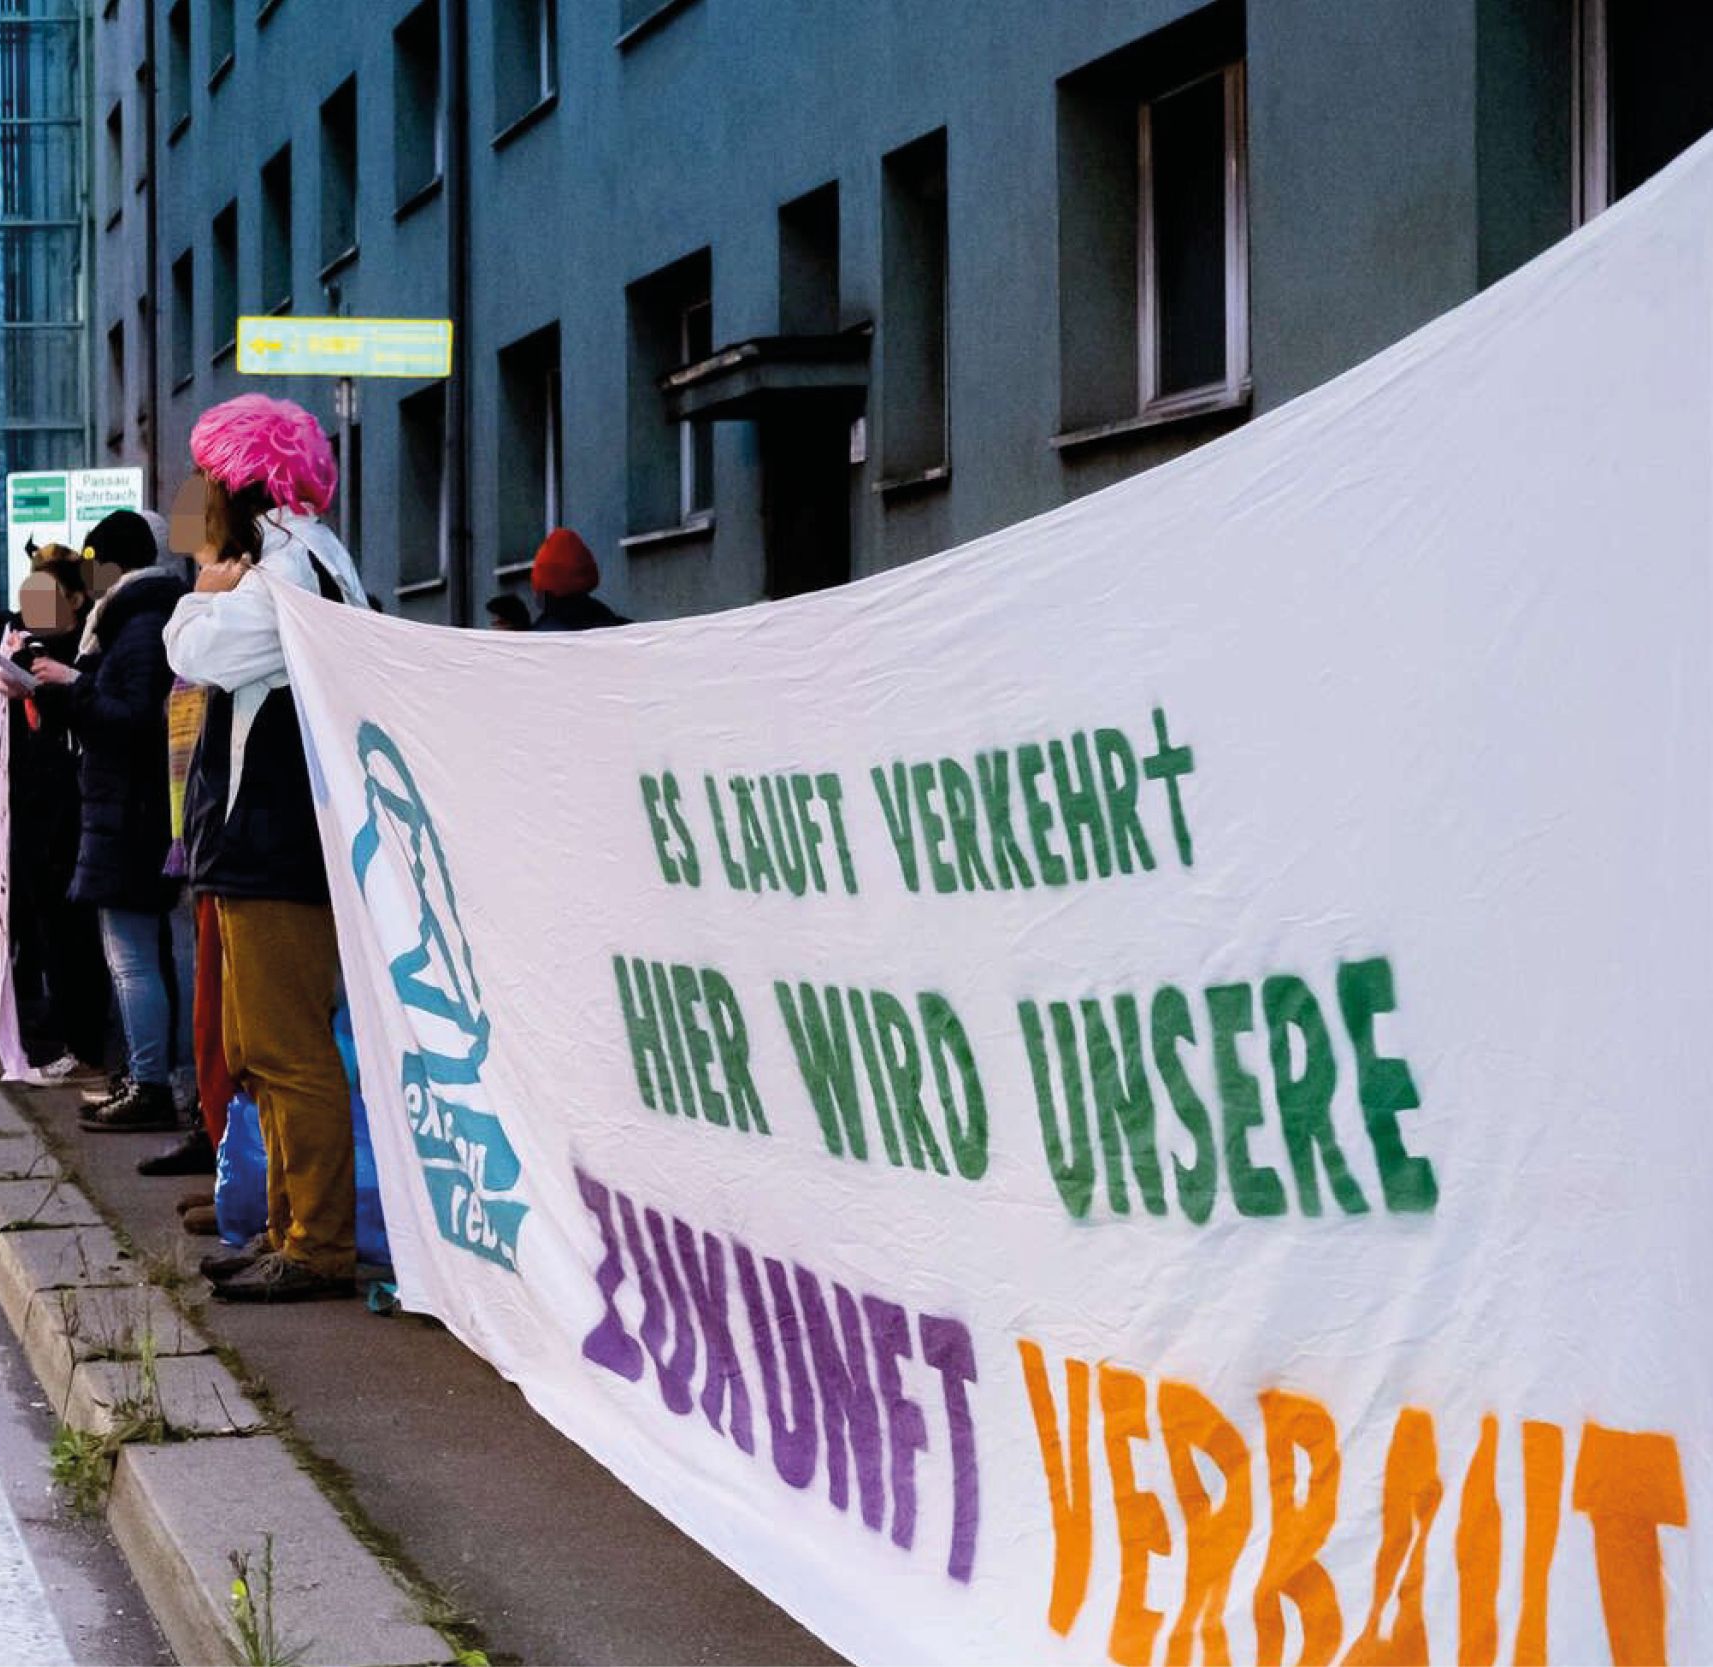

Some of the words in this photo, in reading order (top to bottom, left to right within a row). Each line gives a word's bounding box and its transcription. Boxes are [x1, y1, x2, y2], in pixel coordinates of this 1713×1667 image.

[75, 487, 137, 504] Rohrbach
[82, 473, 130, 486] Passau
[639, 770, 701, 888] ES
[704, 772, 858, 896] LÄUFT
[612, 954, 772, 1136] HIER
[773, 980, 990, 1182] WIRD
[1017, 956, 1440, 1224] UNSERE
[573, 1164, 979, 1585] ZUKUNFT
[1016, 1338, 1689, 1667] VERBAUT
